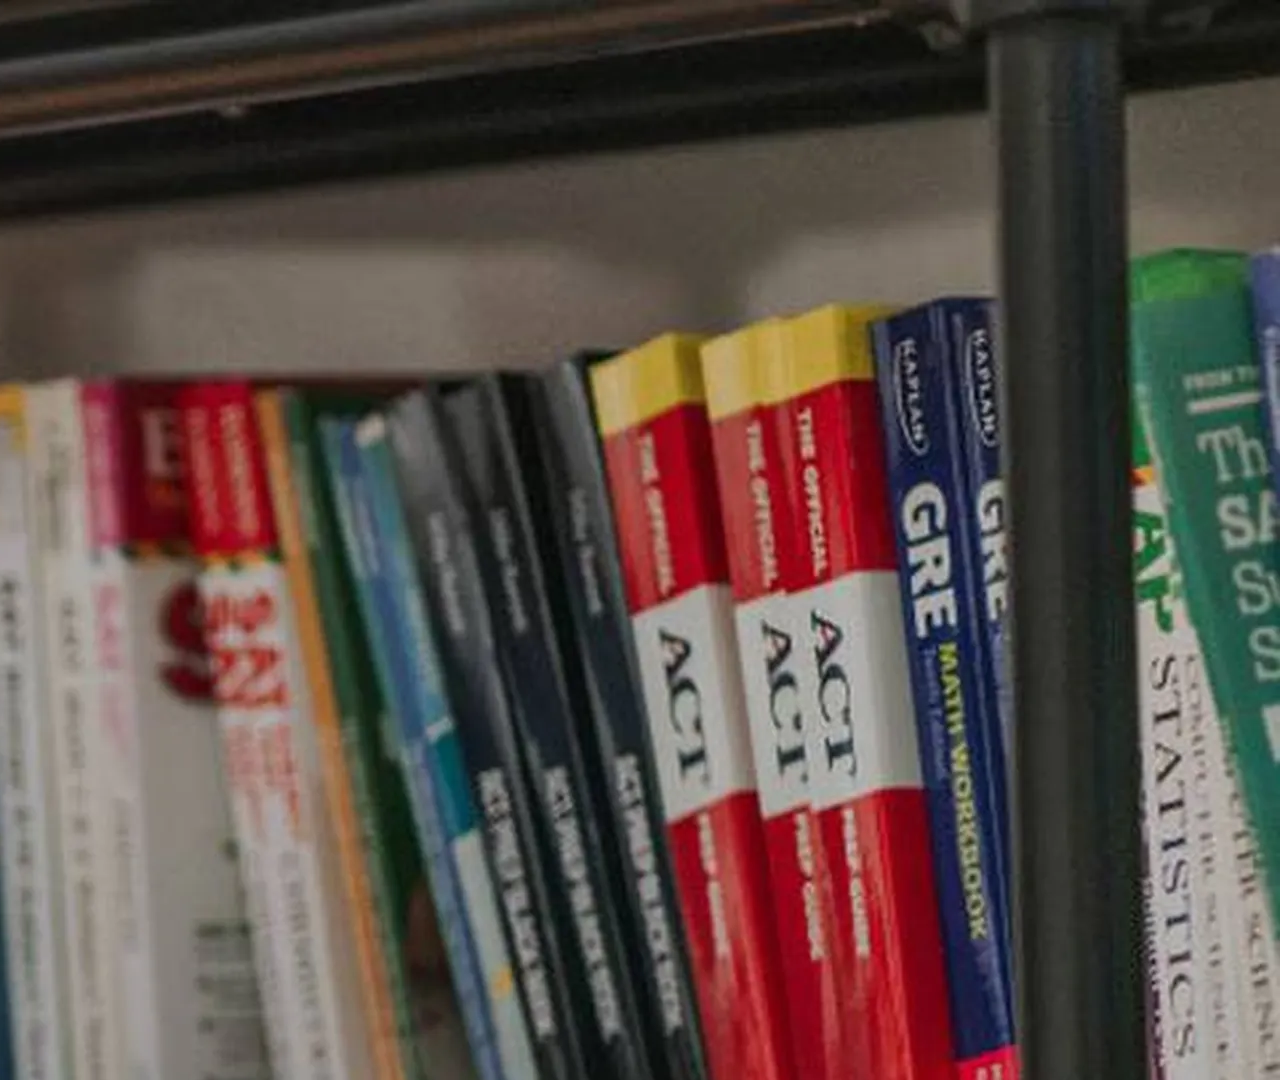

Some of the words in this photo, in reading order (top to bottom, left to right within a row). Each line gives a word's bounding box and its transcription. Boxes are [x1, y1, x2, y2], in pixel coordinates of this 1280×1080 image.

[798, 406, 816, 460] THE
[899, 338, 928, 443] KAPLAN
[971, 328, 997, 442] KAPLAN
[639, 430, 660, 484] THE
[746, 418, 766, 473] THE
[1196, 424, 1269, 488] Th
[646, 486, 677, 598] OFFICIAL
[751, 476, 779, 590] OFFICIAL
[804, 464, 828, 578] OFFICIAL
[902, 481, 958, 640] GRE
[977, 478, 1008, 623] GRE
[1133, 510, 1174, 633] AP
[657, 624, 711, 786] ACT
[760, 618, 810, 785] ACT
[810, 608, 857, 780] ACT
[939, 641, 964, 736] MATH
[697, 810, 718, 877] PREP
[795, 811, 814, 876] PREP
[842, 807, 861, 874] PREP
[950, 740, 989, 941] WORKBOOK
[1151, 655, 1195, 1057] STATISTICS
[1186, 655, 1217, 878] COMPUTER
[1207, 892, 1231, 1063] SCIENCE
[708, 879, 733, 960] GUIDE
[803, 880, 826, 963] GUIDE
[849, 876, 871, 962] GUIDE
[1248, 912, 1280, 1074] SCIENCE
